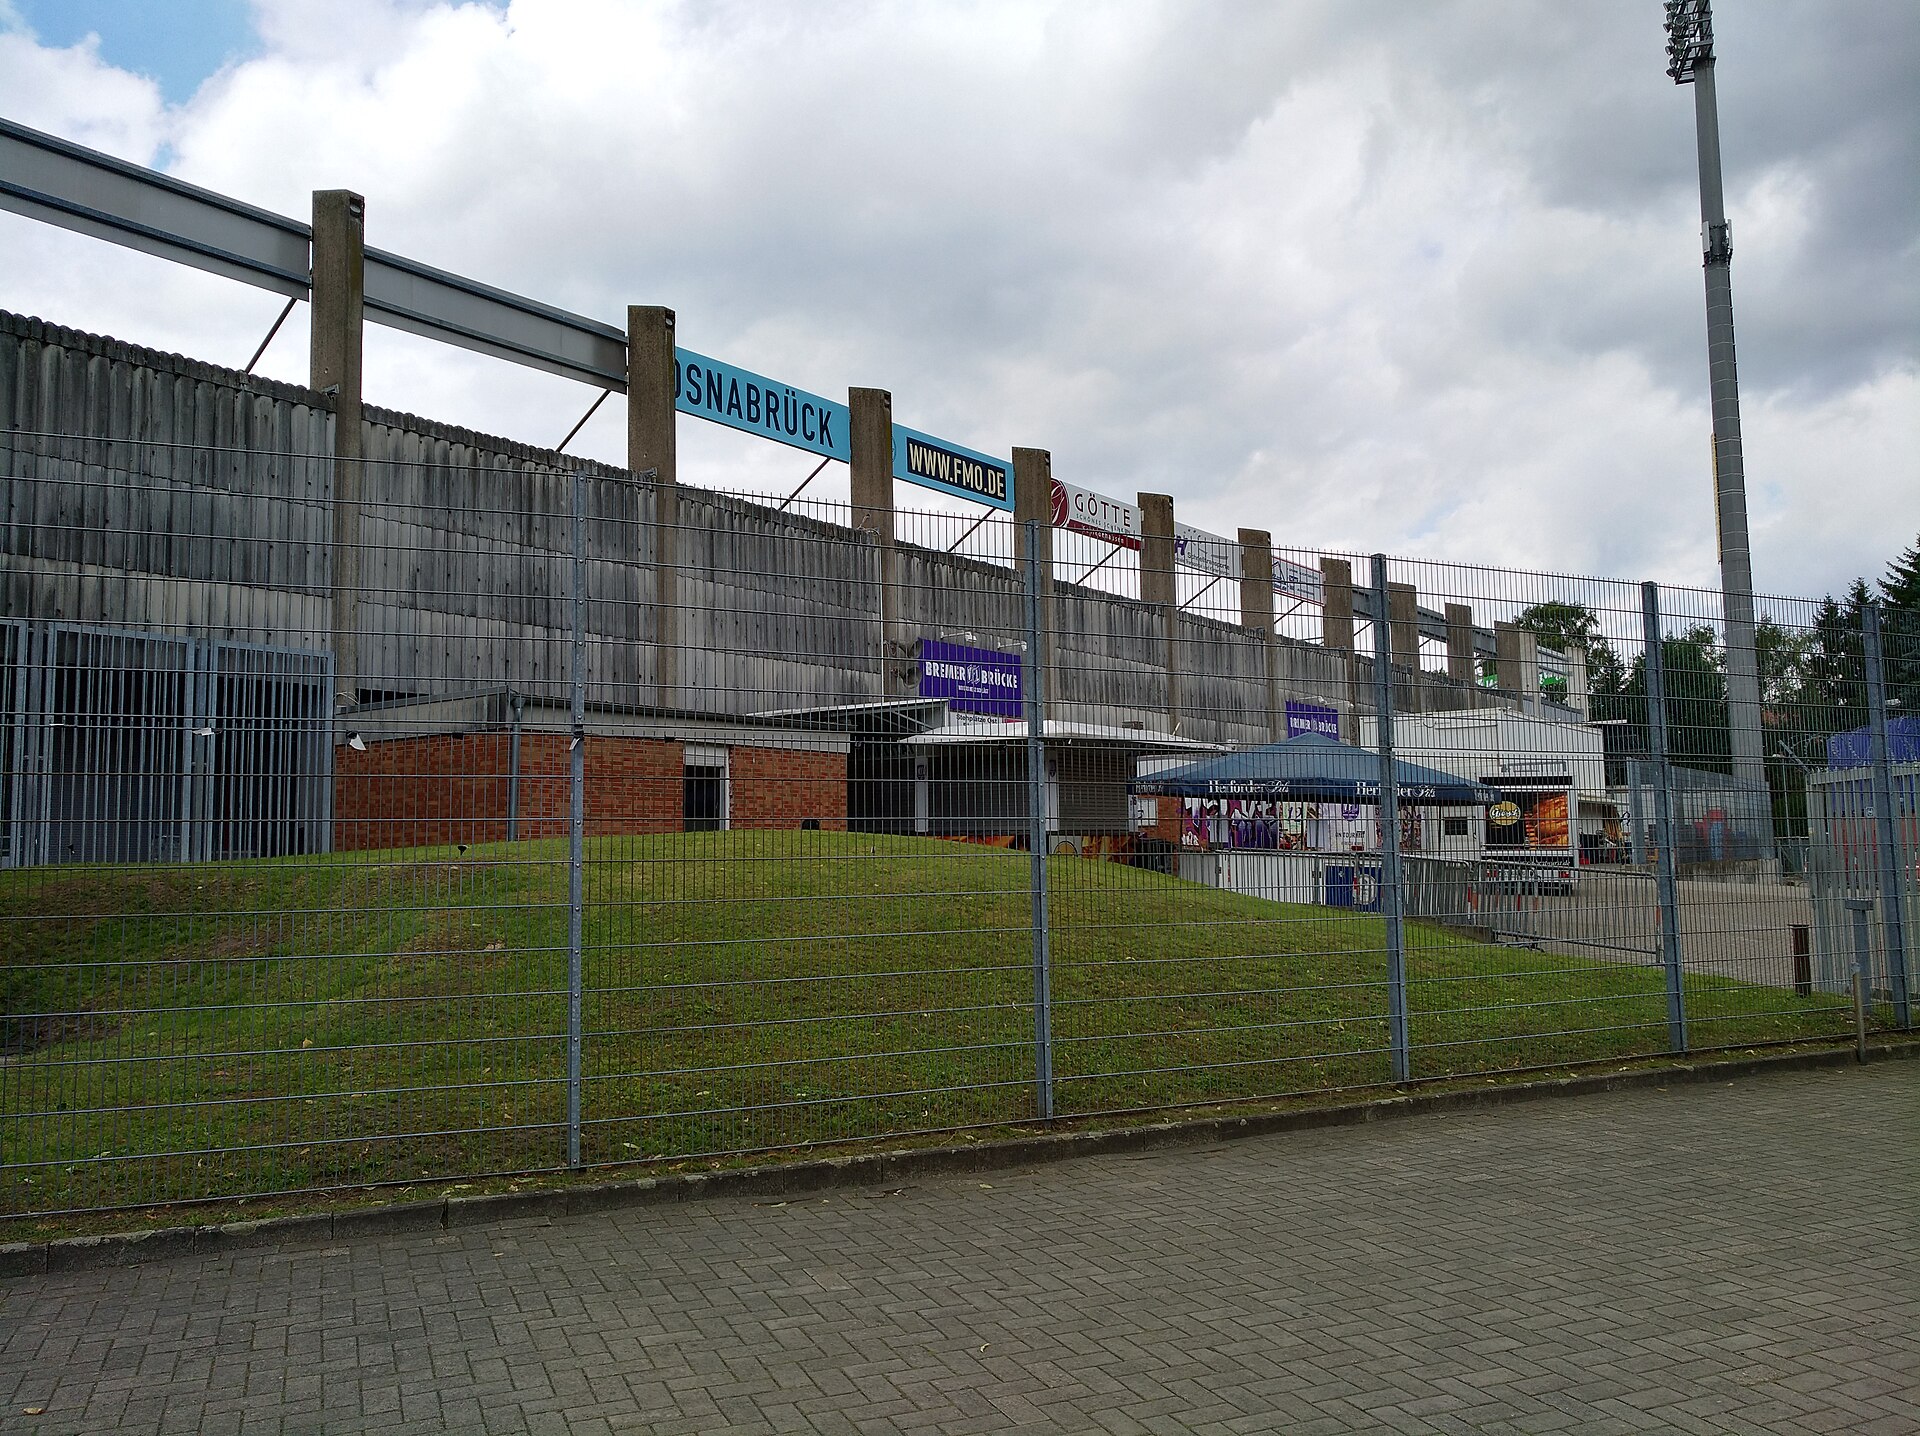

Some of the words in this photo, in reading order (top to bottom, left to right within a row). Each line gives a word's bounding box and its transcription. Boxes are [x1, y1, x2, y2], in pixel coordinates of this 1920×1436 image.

[908, 442, 1005, 498] WWW.FMO.DE
[1074, 492, 1132, 528] GÖTTE
[925, 661, 966, 681] BREMER
[981, 669, 1018, 689] BRÜCKE
[1207, 779, 1265, 793] Herforder
[1355, 781, 1412, 798] Herer
